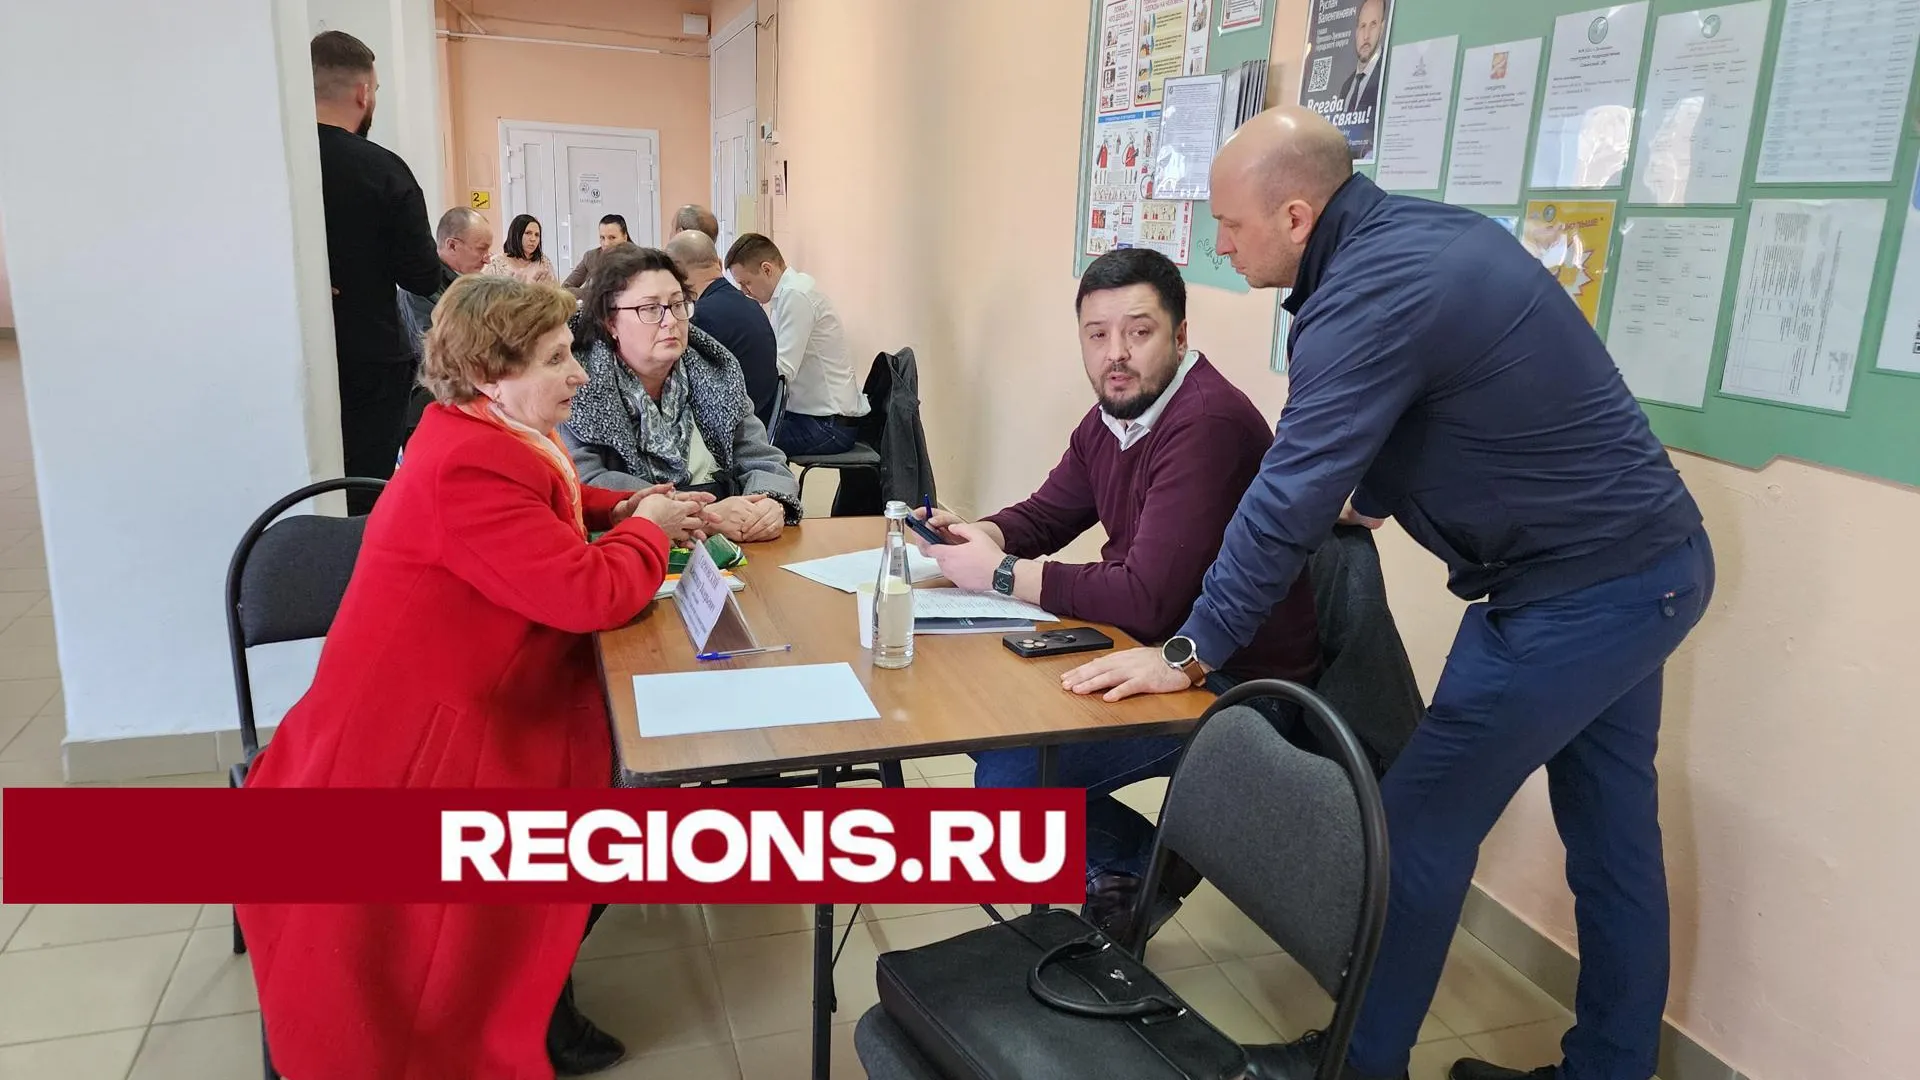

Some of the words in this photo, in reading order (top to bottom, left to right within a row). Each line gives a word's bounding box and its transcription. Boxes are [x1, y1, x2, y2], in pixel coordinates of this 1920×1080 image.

[1307, 95, 1345, 114] Всегда
[1332, 105, 1372, 127] связи!
[473, 192, 480, 202] 2
